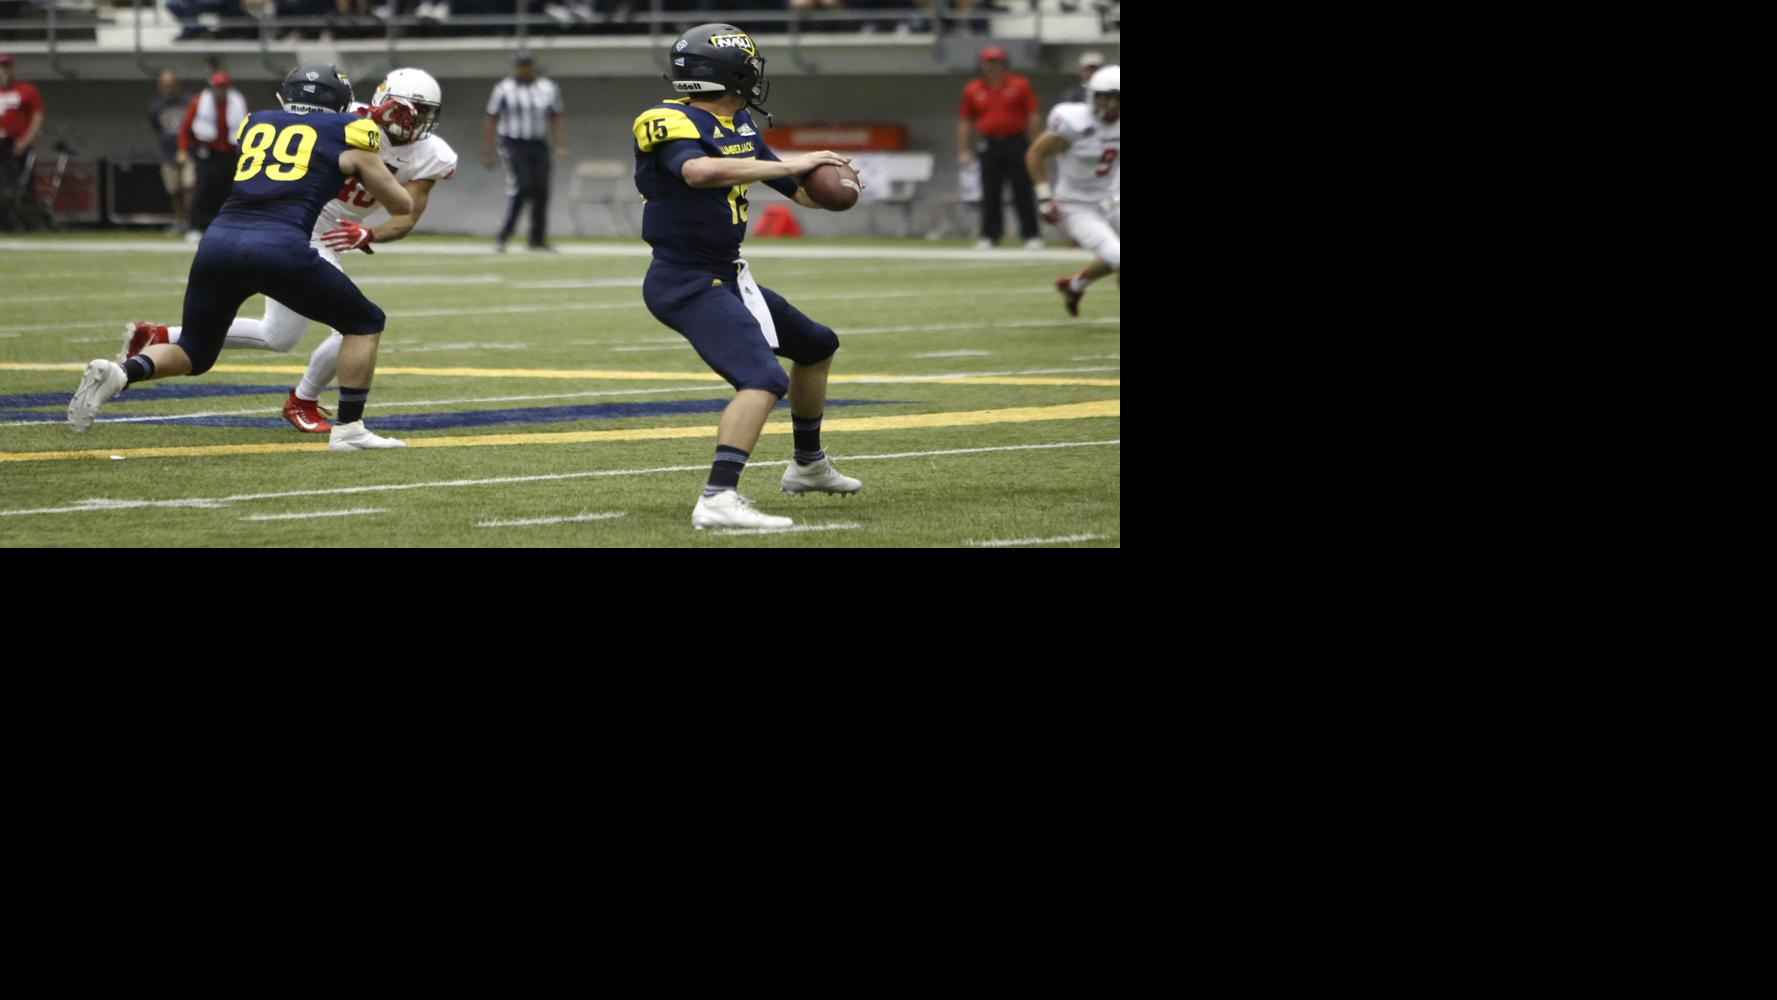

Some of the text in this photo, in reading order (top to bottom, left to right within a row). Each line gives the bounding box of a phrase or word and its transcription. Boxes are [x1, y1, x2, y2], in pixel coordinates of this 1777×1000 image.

[716, 36, 751, 49] NAU
[643, 118, 668, 143] 15
[233, 123, 318, 182] 89
